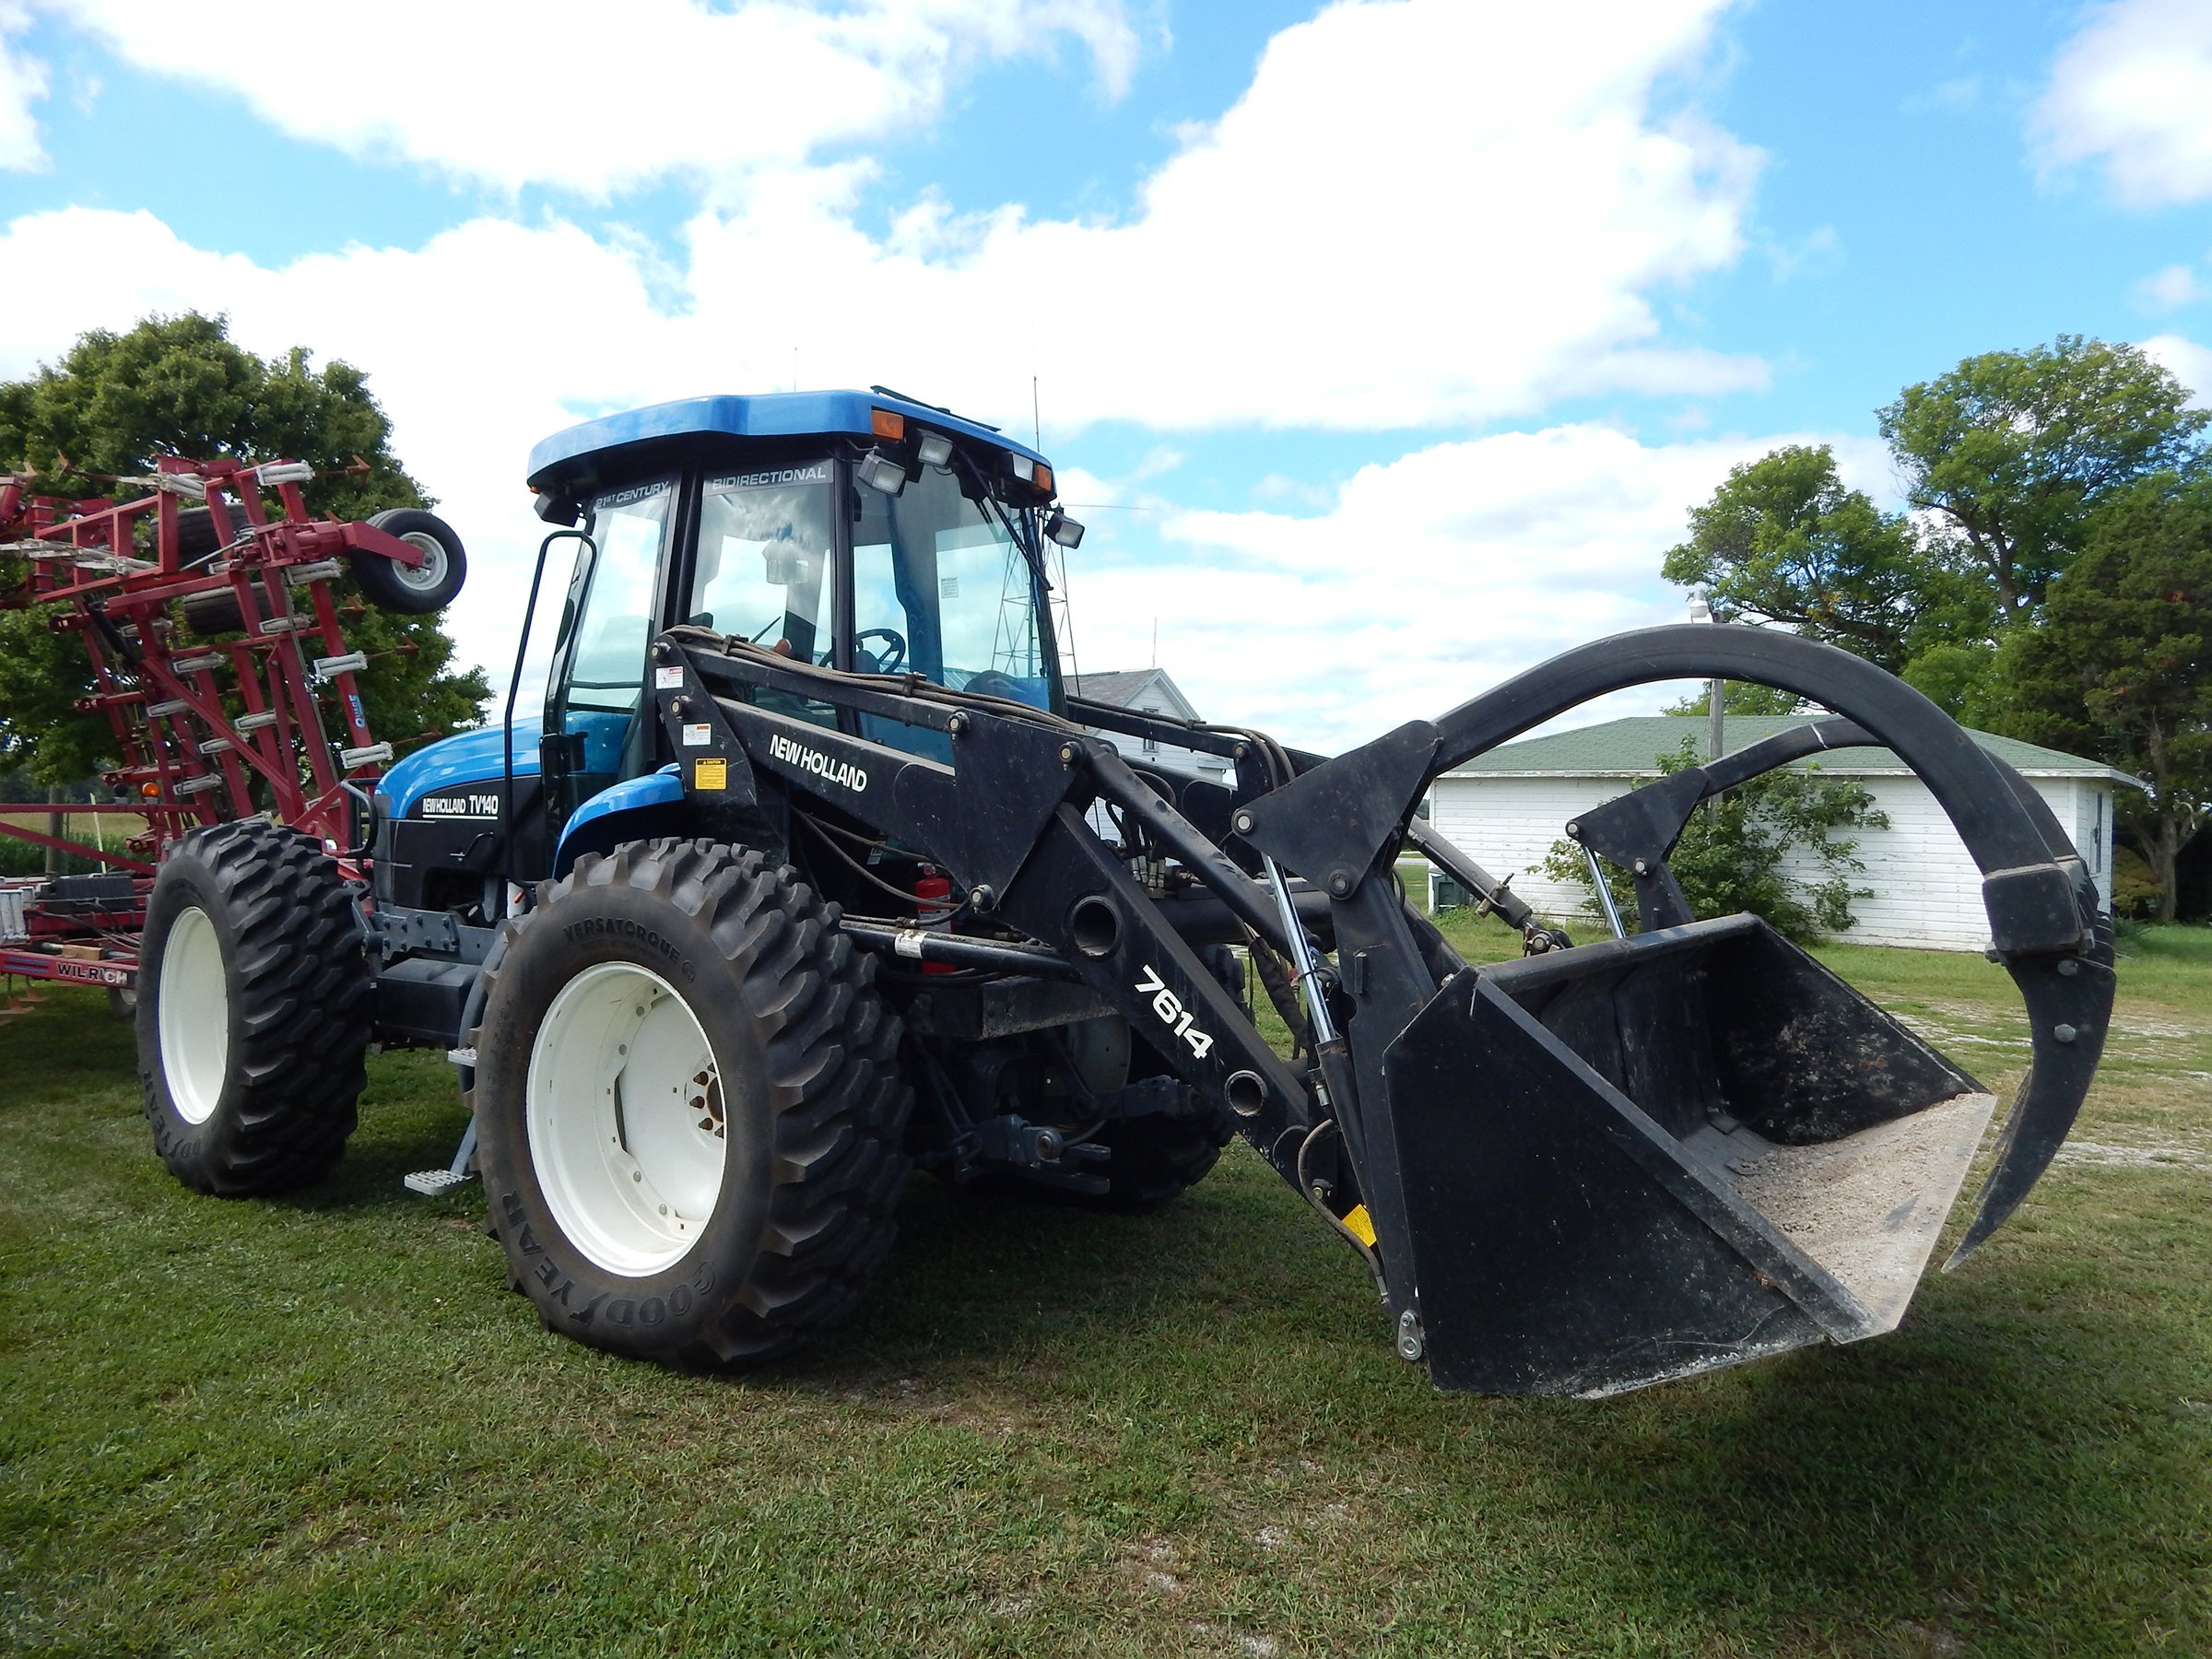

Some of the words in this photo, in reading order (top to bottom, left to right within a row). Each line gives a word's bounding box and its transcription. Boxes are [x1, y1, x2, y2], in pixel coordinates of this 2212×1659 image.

[616, 480, 669, 503] CENTURY
[712, 466, 827, 490] BIDIRECTIONAL
[770, 734, 803, 765] NEW
[800, 747, 868, 792] HOLLAND
[422, 798, 437, 813] NEW
[436, 798, 466, 814] HOLLAND
[468, 794, 499, 815] TV140
[562, 915, 681, 964] VERSATORQUE
[1134, 963, 1215, 1060] 7614
